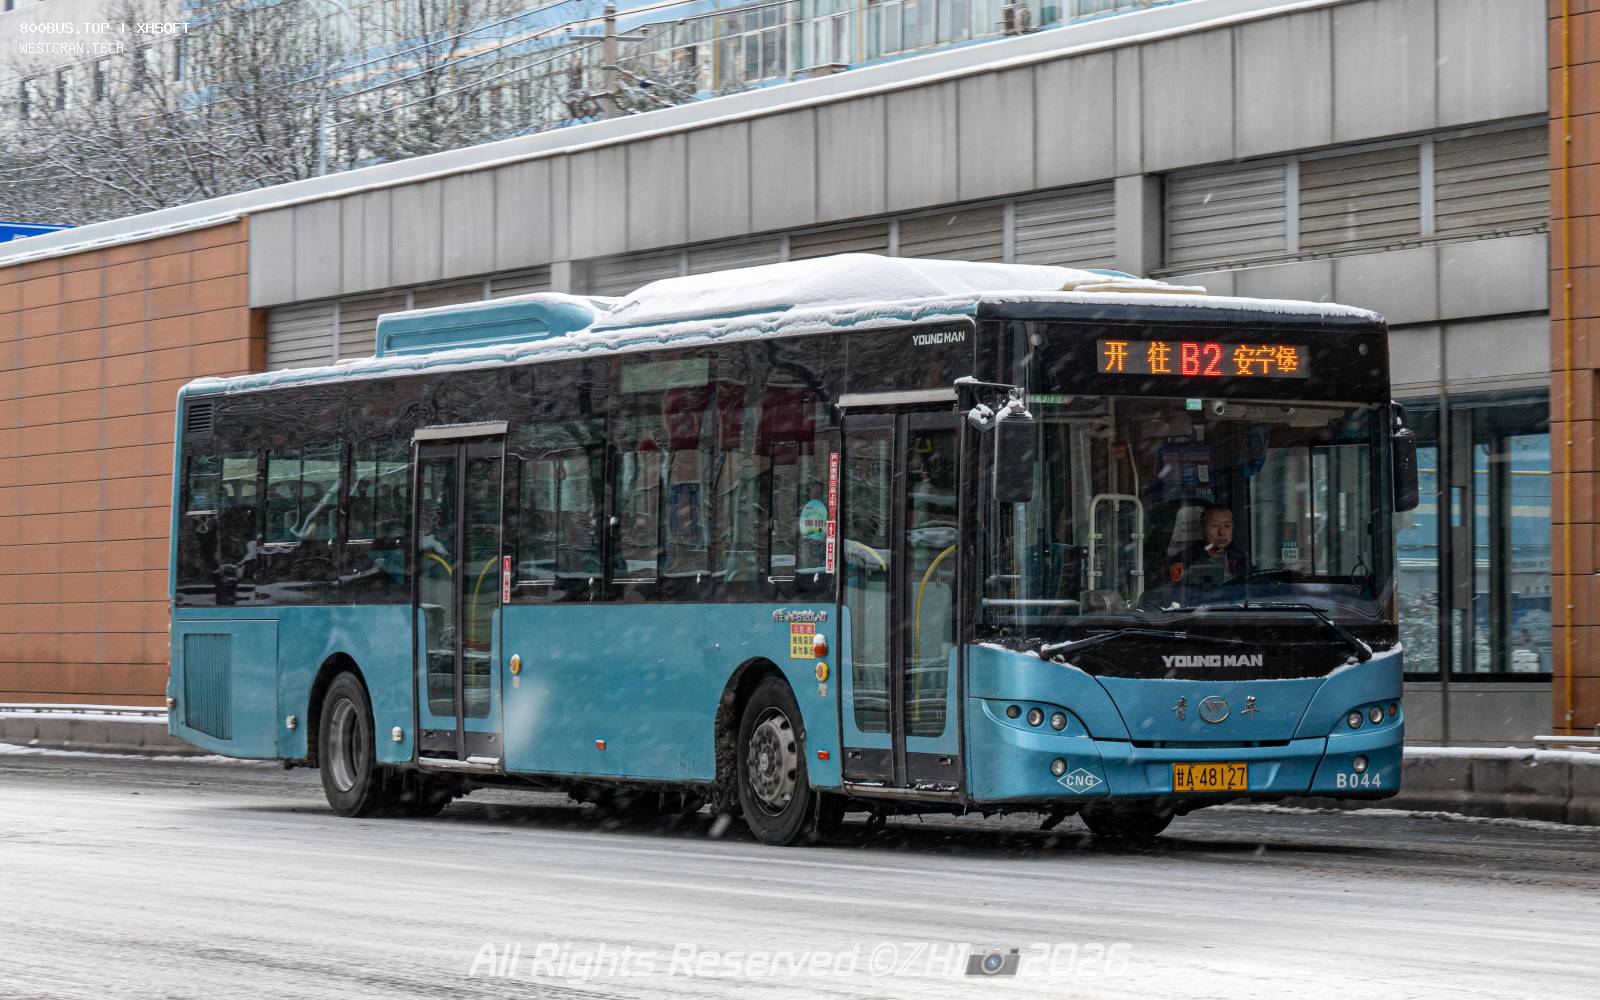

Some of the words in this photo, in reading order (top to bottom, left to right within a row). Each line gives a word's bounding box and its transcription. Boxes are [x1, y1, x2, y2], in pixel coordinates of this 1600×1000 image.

[1181, 343, 1222, 376] B2
[1233, 344, 1298, 375] 安宁堡
[1066, 774, 1094, 787] CNG
[1336, 773, 1382, 789] B044
